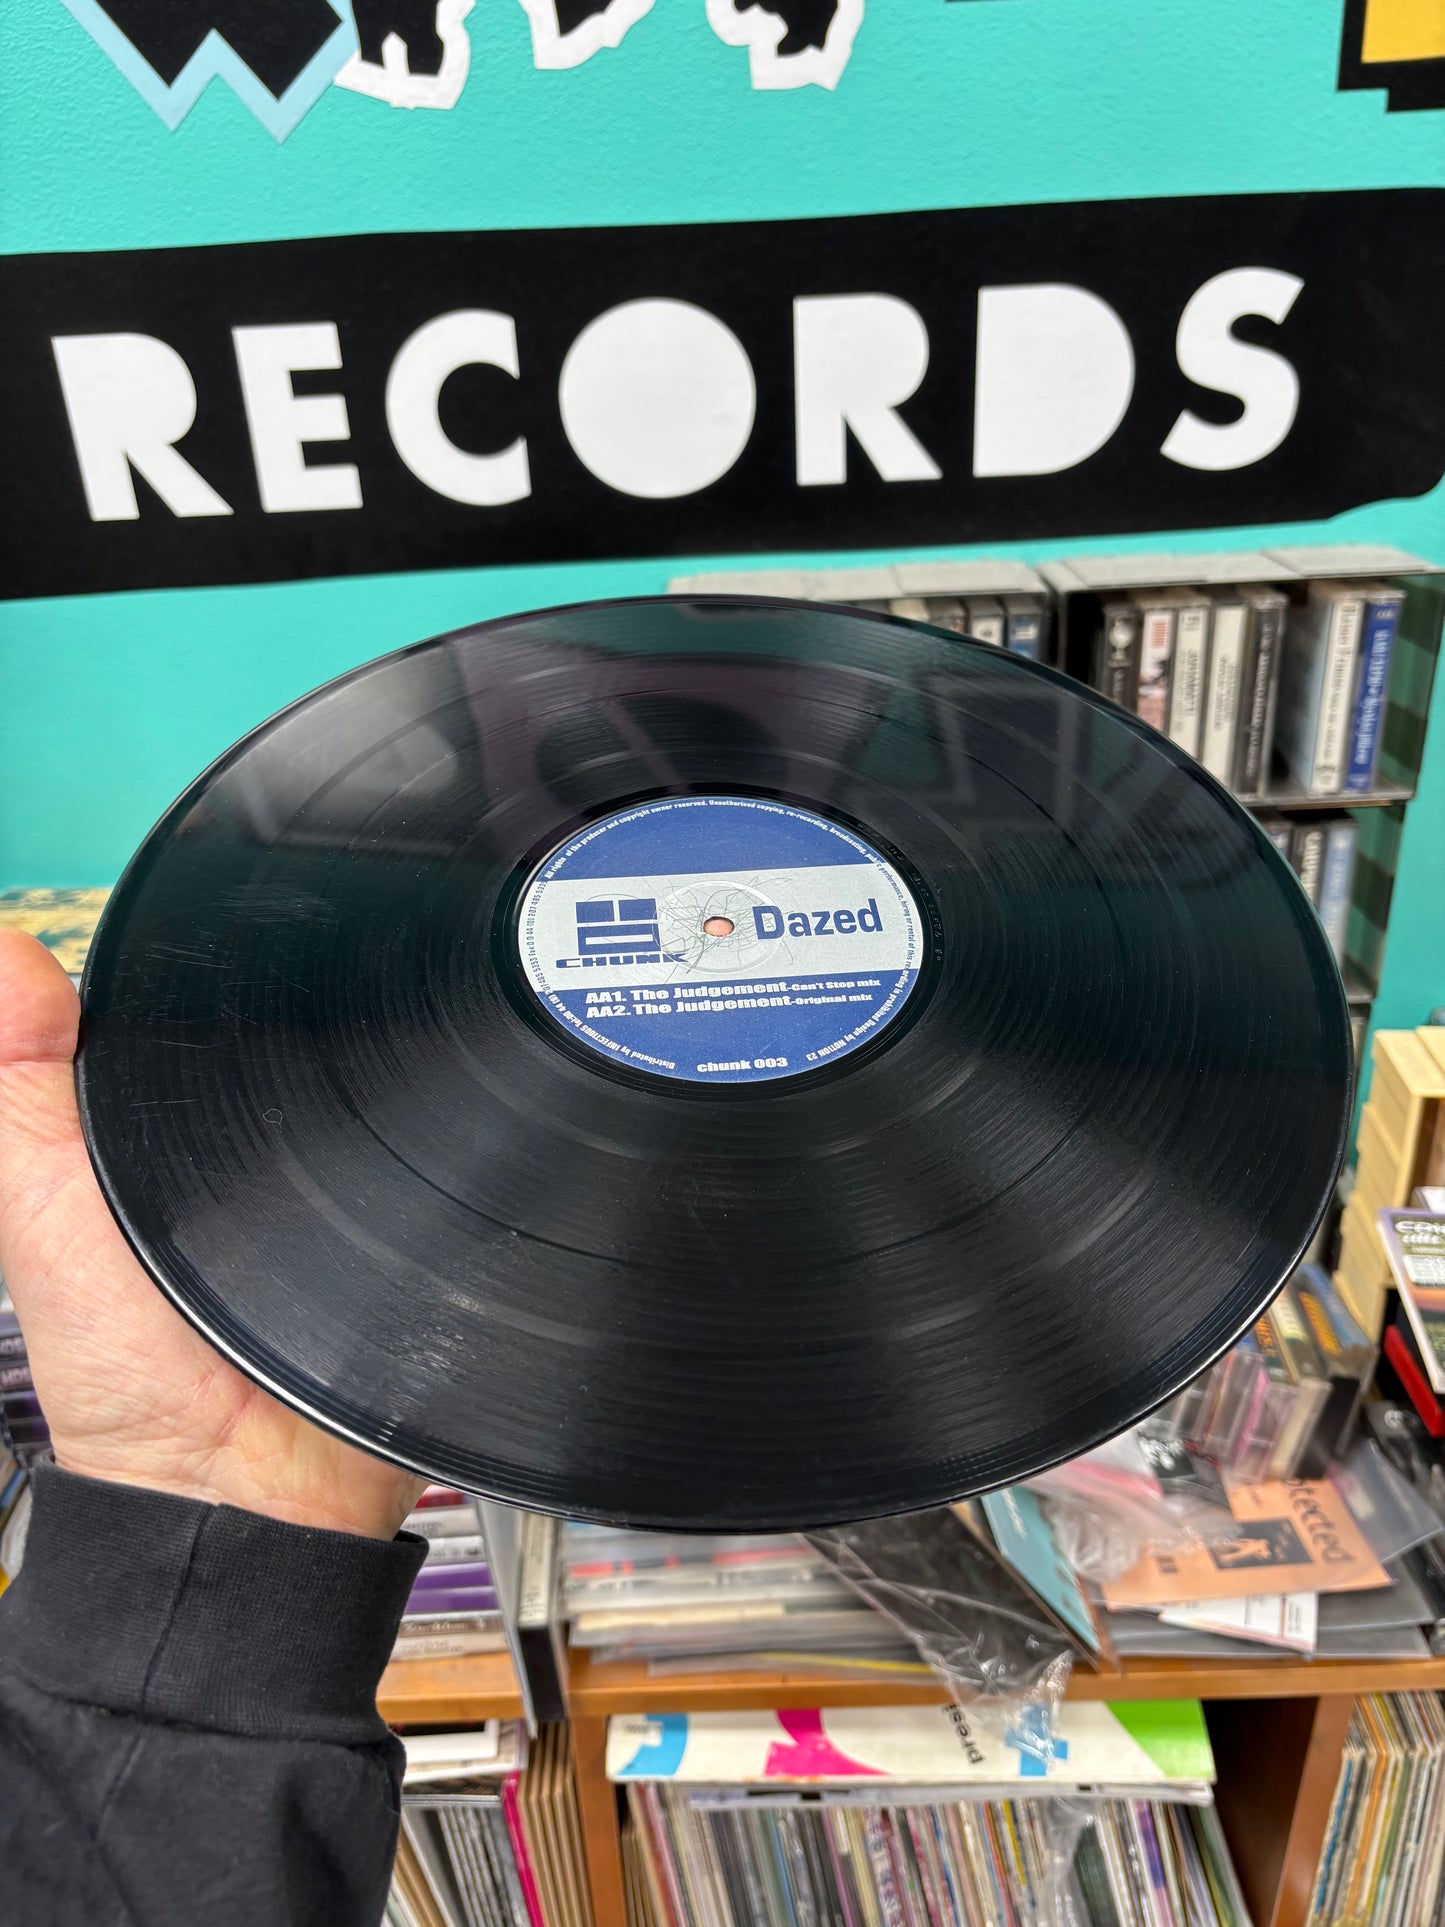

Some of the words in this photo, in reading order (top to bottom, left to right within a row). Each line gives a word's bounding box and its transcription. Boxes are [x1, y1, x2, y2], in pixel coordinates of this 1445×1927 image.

[51, 265, 1305, 521] RECORDS
[650, 804, 672, 813] owner
[673, 800, 707, 808] reserved.
[708, 799, 756, 808] Unauthorised
[756, 804, 785, 814] copying,
[618, 809, 650, 823] copyright
[606, 819, 619, 829] and
[580, 826, 606, 845] producer
[829, 827, 866, 854] broadcasting,
[569, 842, 582, 852] the
[550, 857, 566, 872] rights
[544, 870, 554, 879] All
[878, 867, 904, 900] performance,
[527, 906, 537, 917] 207
[752, 898, 883, 940] Dazed
[907, 924, 916, 941] rental
[906, 949, 915, 960] this
[893, 960, 912, 990] reording
[585, 991, 627, 1004] AA1.
[630, 988, 670, 1001] The
[825, 979, 856, 989] Stop
[857, 978, 881, 987] mix
[555, 1002, 566, 1012] 44
[586, 1005, 631, 1018] AA2.
[632, 1002, 672, 1015] The
[848, 993, 873, 1002] mix
[871, 993, 897, 1021] prohibited
[852, 1019, 876, 1036] Design
[580, 1024, 620, 1051] INFECTIOUS
[843, 1033, 856, 1042] by
[620, 1045, 631, 1056] by
[817, 1039, 846, 1057] NOTION
[630, 1051, 675, 1069] Distributed
[805, 1052, 818, 1061] 23
[697, 1059, 751, 1073] chunk
[754, 1057, 788, 1069] 003
